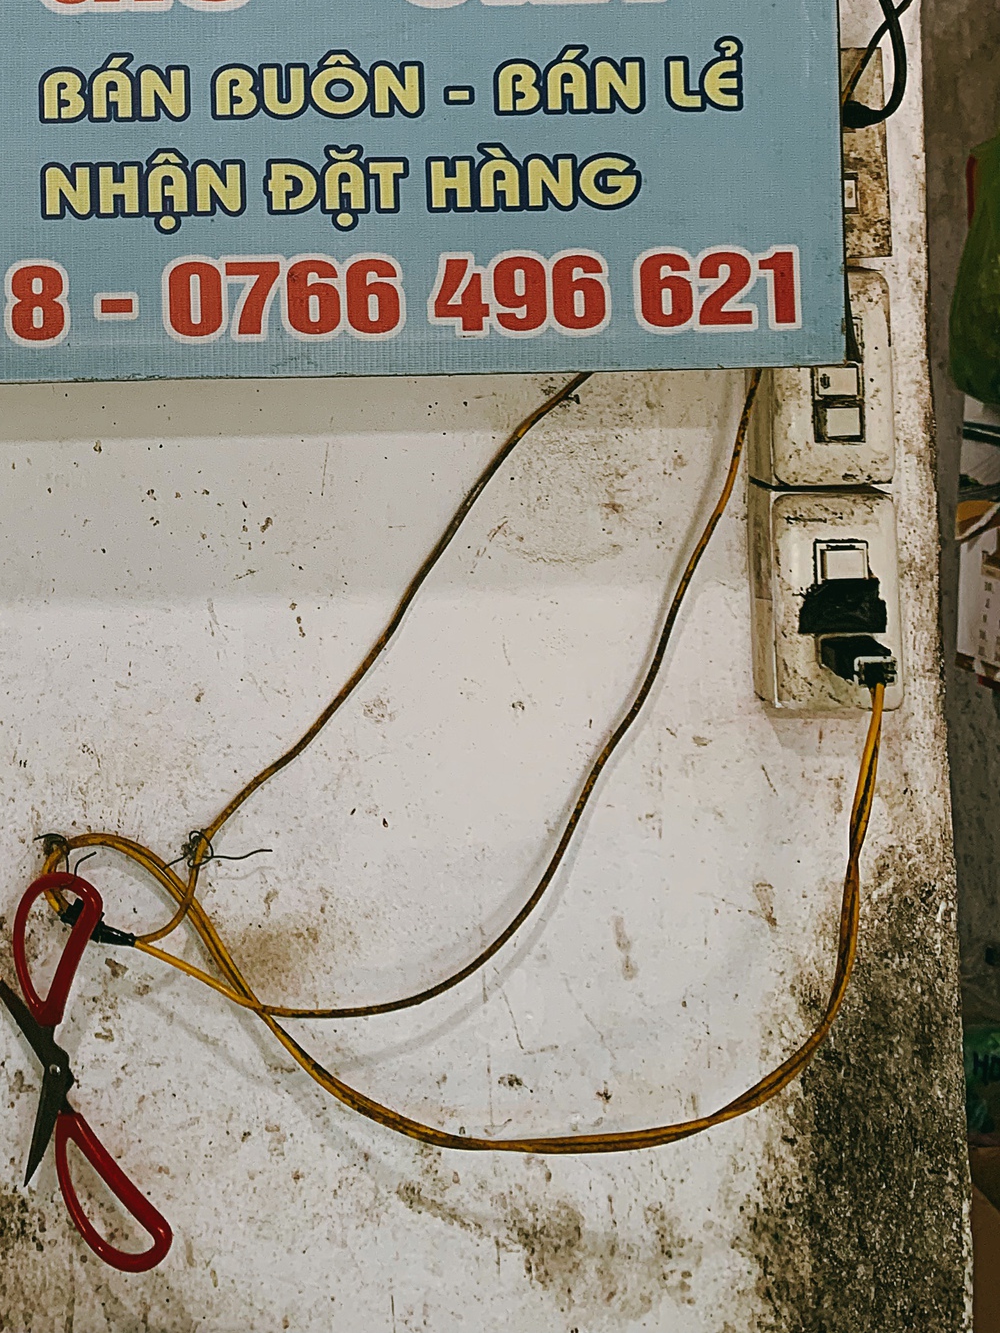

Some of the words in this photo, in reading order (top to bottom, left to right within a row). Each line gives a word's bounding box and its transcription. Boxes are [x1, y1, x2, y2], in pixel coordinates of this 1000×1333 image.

[38, 53, 191, 125] BÁN
[210, 48, 425, 121] BUÔN
[493, 44, 645, 116] BÁN
[664, 36, 745, 113] LẺ
[40, 147, 247, 234] NHẬN
[262, 144, 407, 231] ĐẶT
[425, 142, 642, 213] HÀNG
[162, 253, 407, 341] 0766
[431, 251, 613, 337] 496
[632, 247, 803, 336] 621
